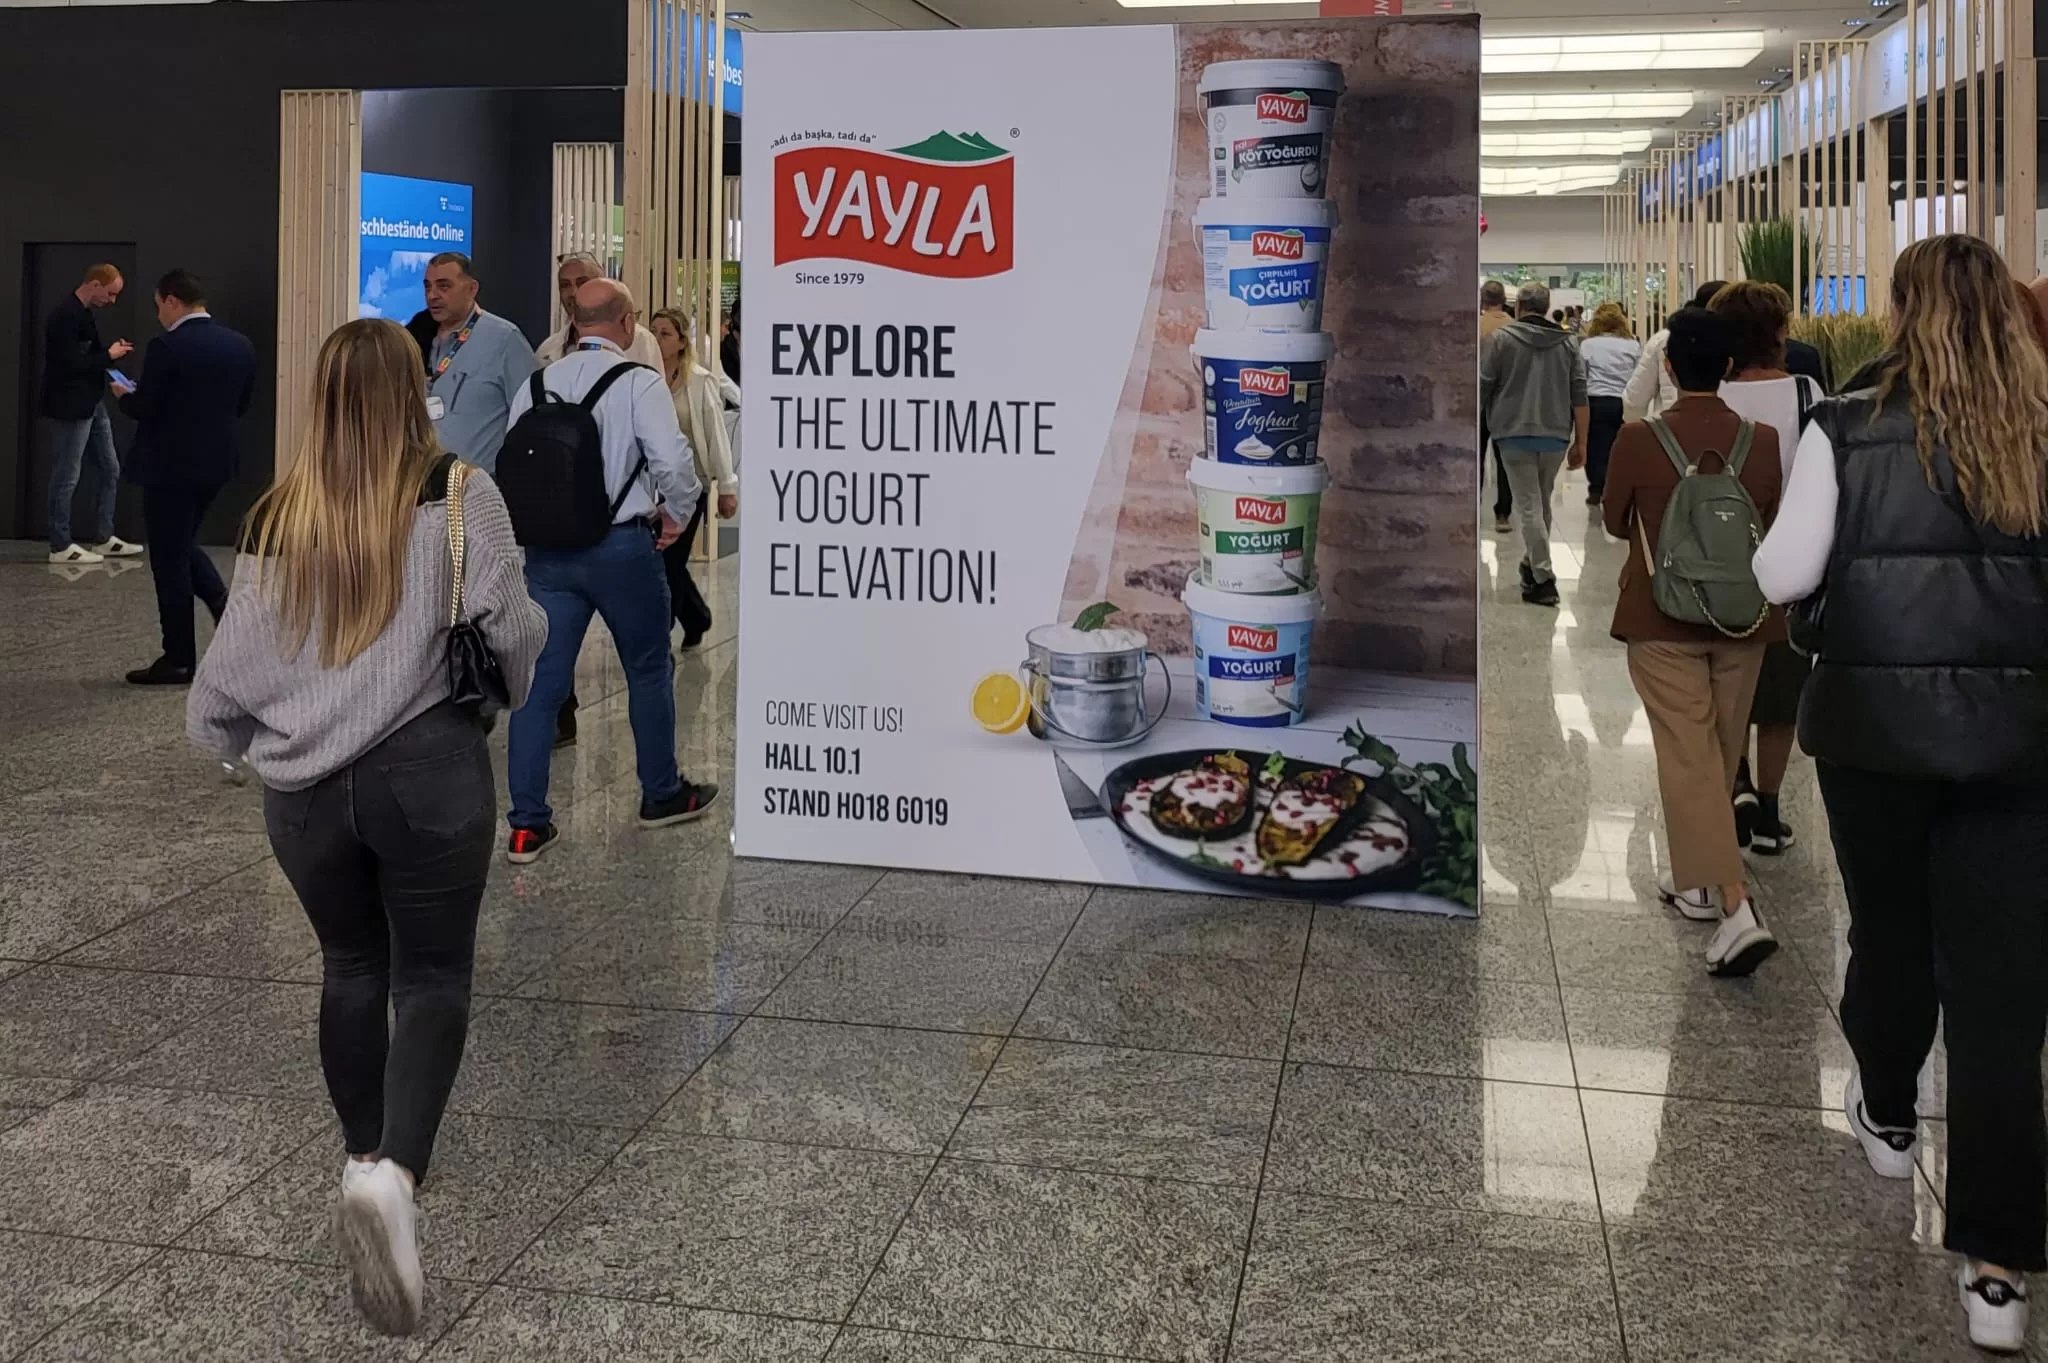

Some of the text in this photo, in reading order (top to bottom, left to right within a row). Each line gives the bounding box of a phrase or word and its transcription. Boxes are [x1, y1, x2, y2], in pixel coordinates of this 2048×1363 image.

[1261, 98, 1306, 119] YAYLA
[790, 131, 803, 141] da
[1239, 148, 1263, 164] KÖY
[1264, 145, 1318, 160] YOĞURDU
[793, 167, 996, 257] YAYLA
[431, 223, 464, 242] Online
[1256, 236, 1301, 256] YAYLA
[795, 272, 865, 285] Since 1979
[1238, 279, 1312, 300] YOĞURT
[771, 323, 956, 378] EXPLORE
[1243, 373, 1286, 391] YAYLA
[770, 396, 1056, 455] THE ULTIMATE
[1234, 407, 1300, 434] Joghurt
[770, 469, 930, 526] YOGURT
[1238, 501, 1283, 521] YAYLA
[770, 543, 996, 605] ELEVATION!
[1231, 629, 1275, 648] YAYLA
[765, 700, 904, 733] COME VISIT US!
[765, 742, 861, 775] HALL 10.1
[764, 786, 831, 818] STAND
